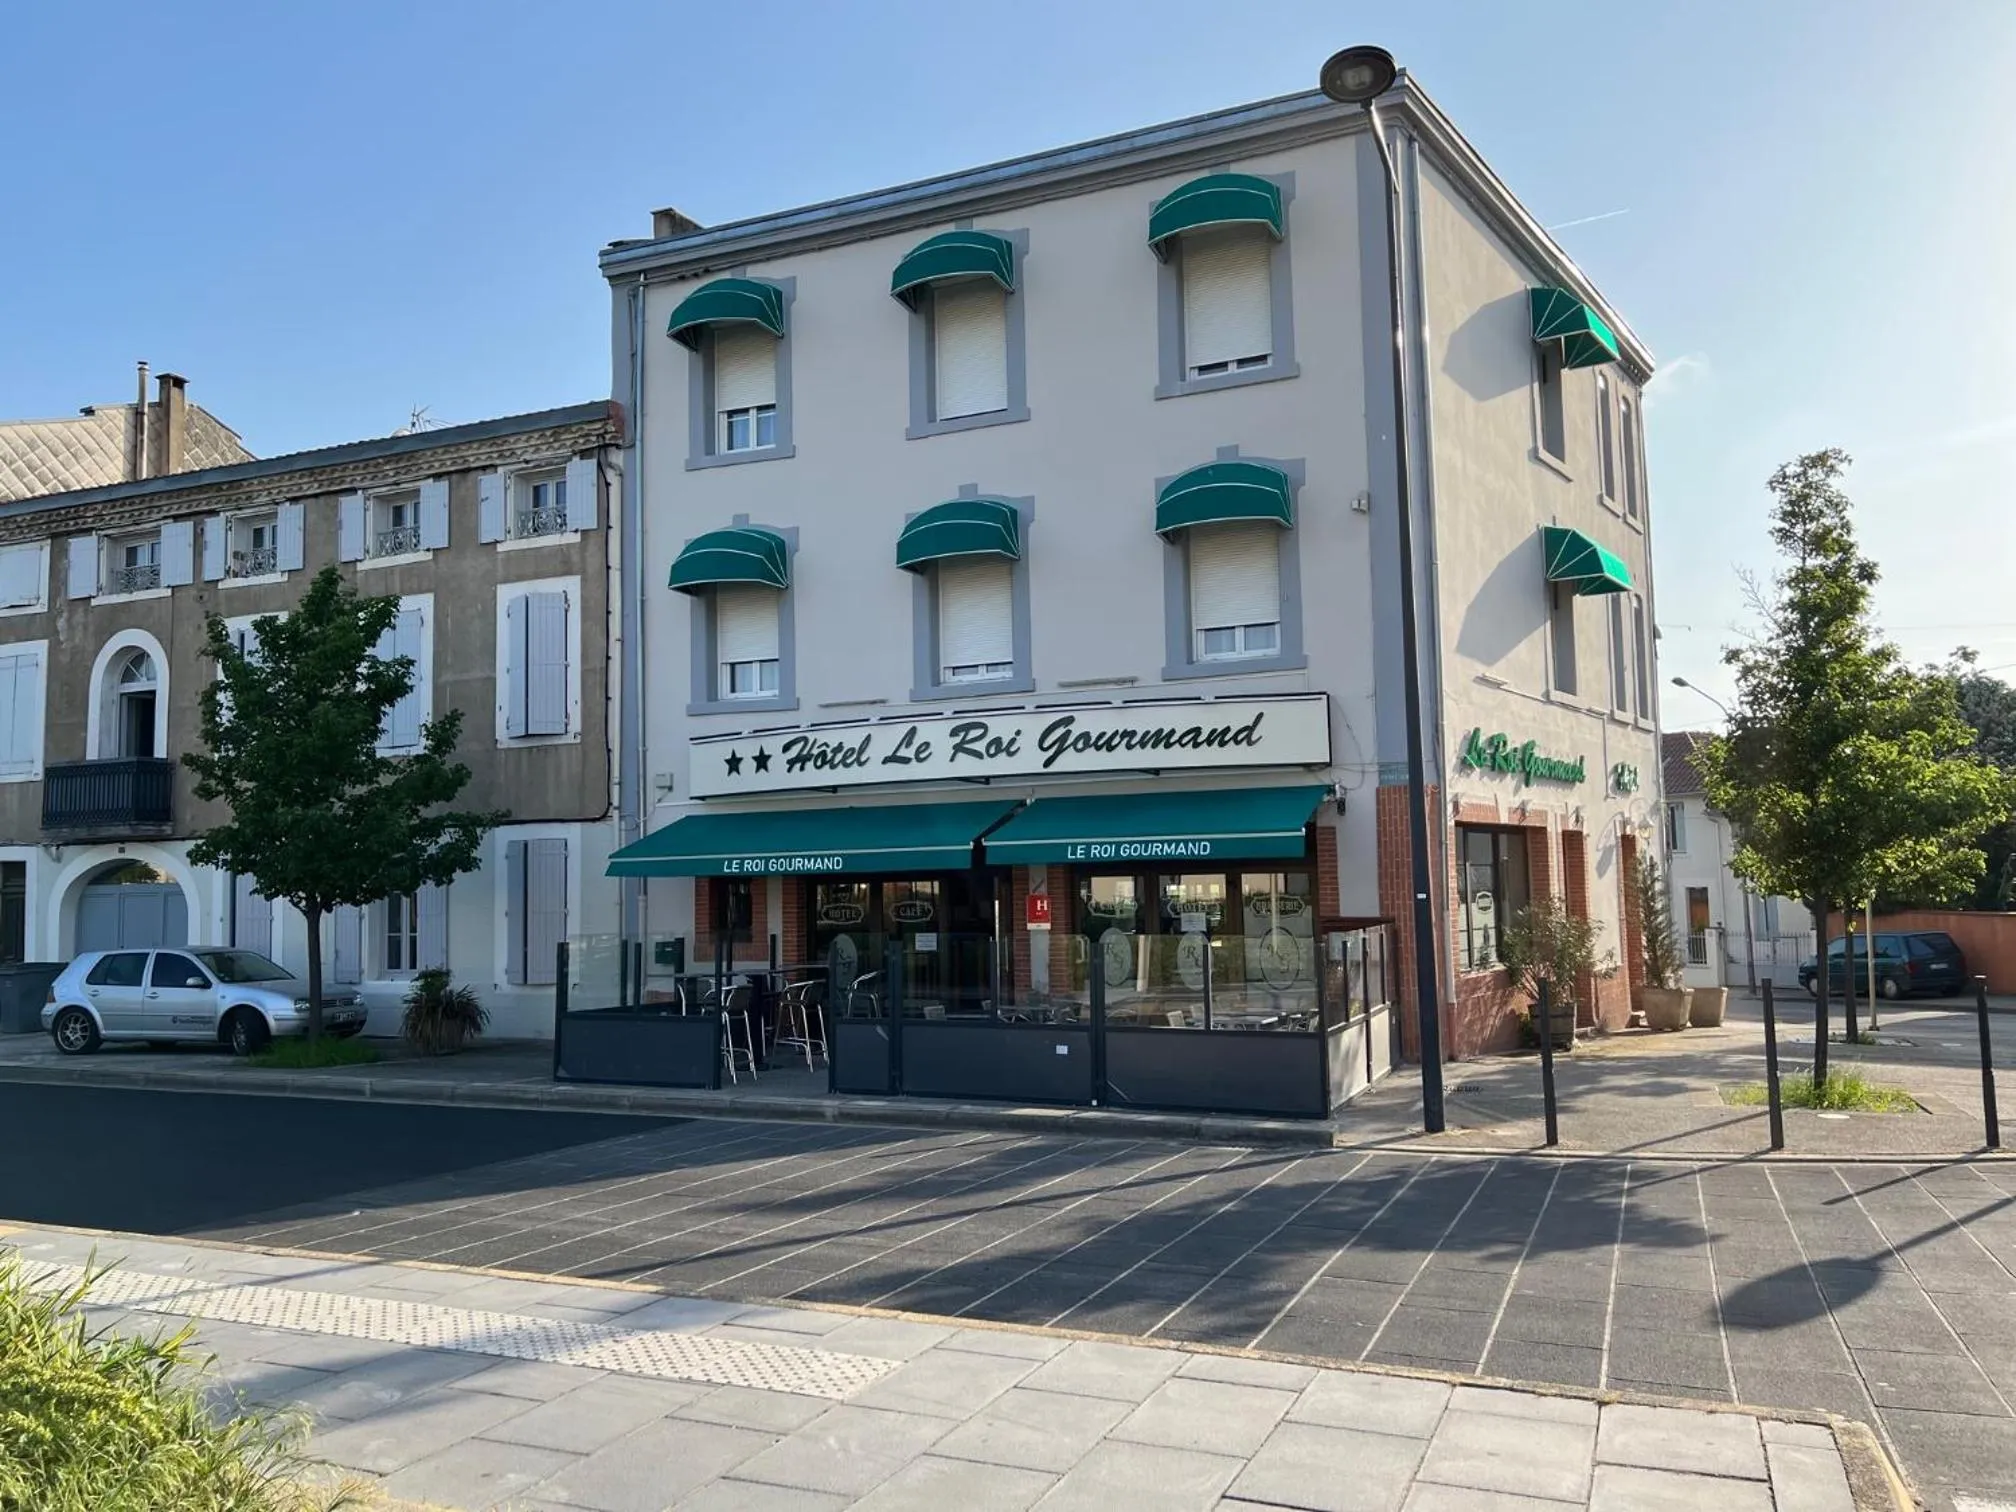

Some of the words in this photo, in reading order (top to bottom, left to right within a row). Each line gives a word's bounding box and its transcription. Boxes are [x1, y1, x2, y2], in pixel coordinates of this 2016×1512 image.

[782, 733, 872, 774] Hôtel
[882, 726, 933, 765] Le
[949, 721, 1022, 763] Roi
[1037, 711, 1265, 769] Gourmand
[1067, 844, 1087, 859] LE
[1090, 843, 1116, 858] ROI
[1120, 841, 1211, 857] GOURMAND
[723, 859, 741, 873] LE
[743, 858, 765, 872] ROI
[768, 856, 843, 872] GOURMAND
[1036, 899, 1049, 911] H
